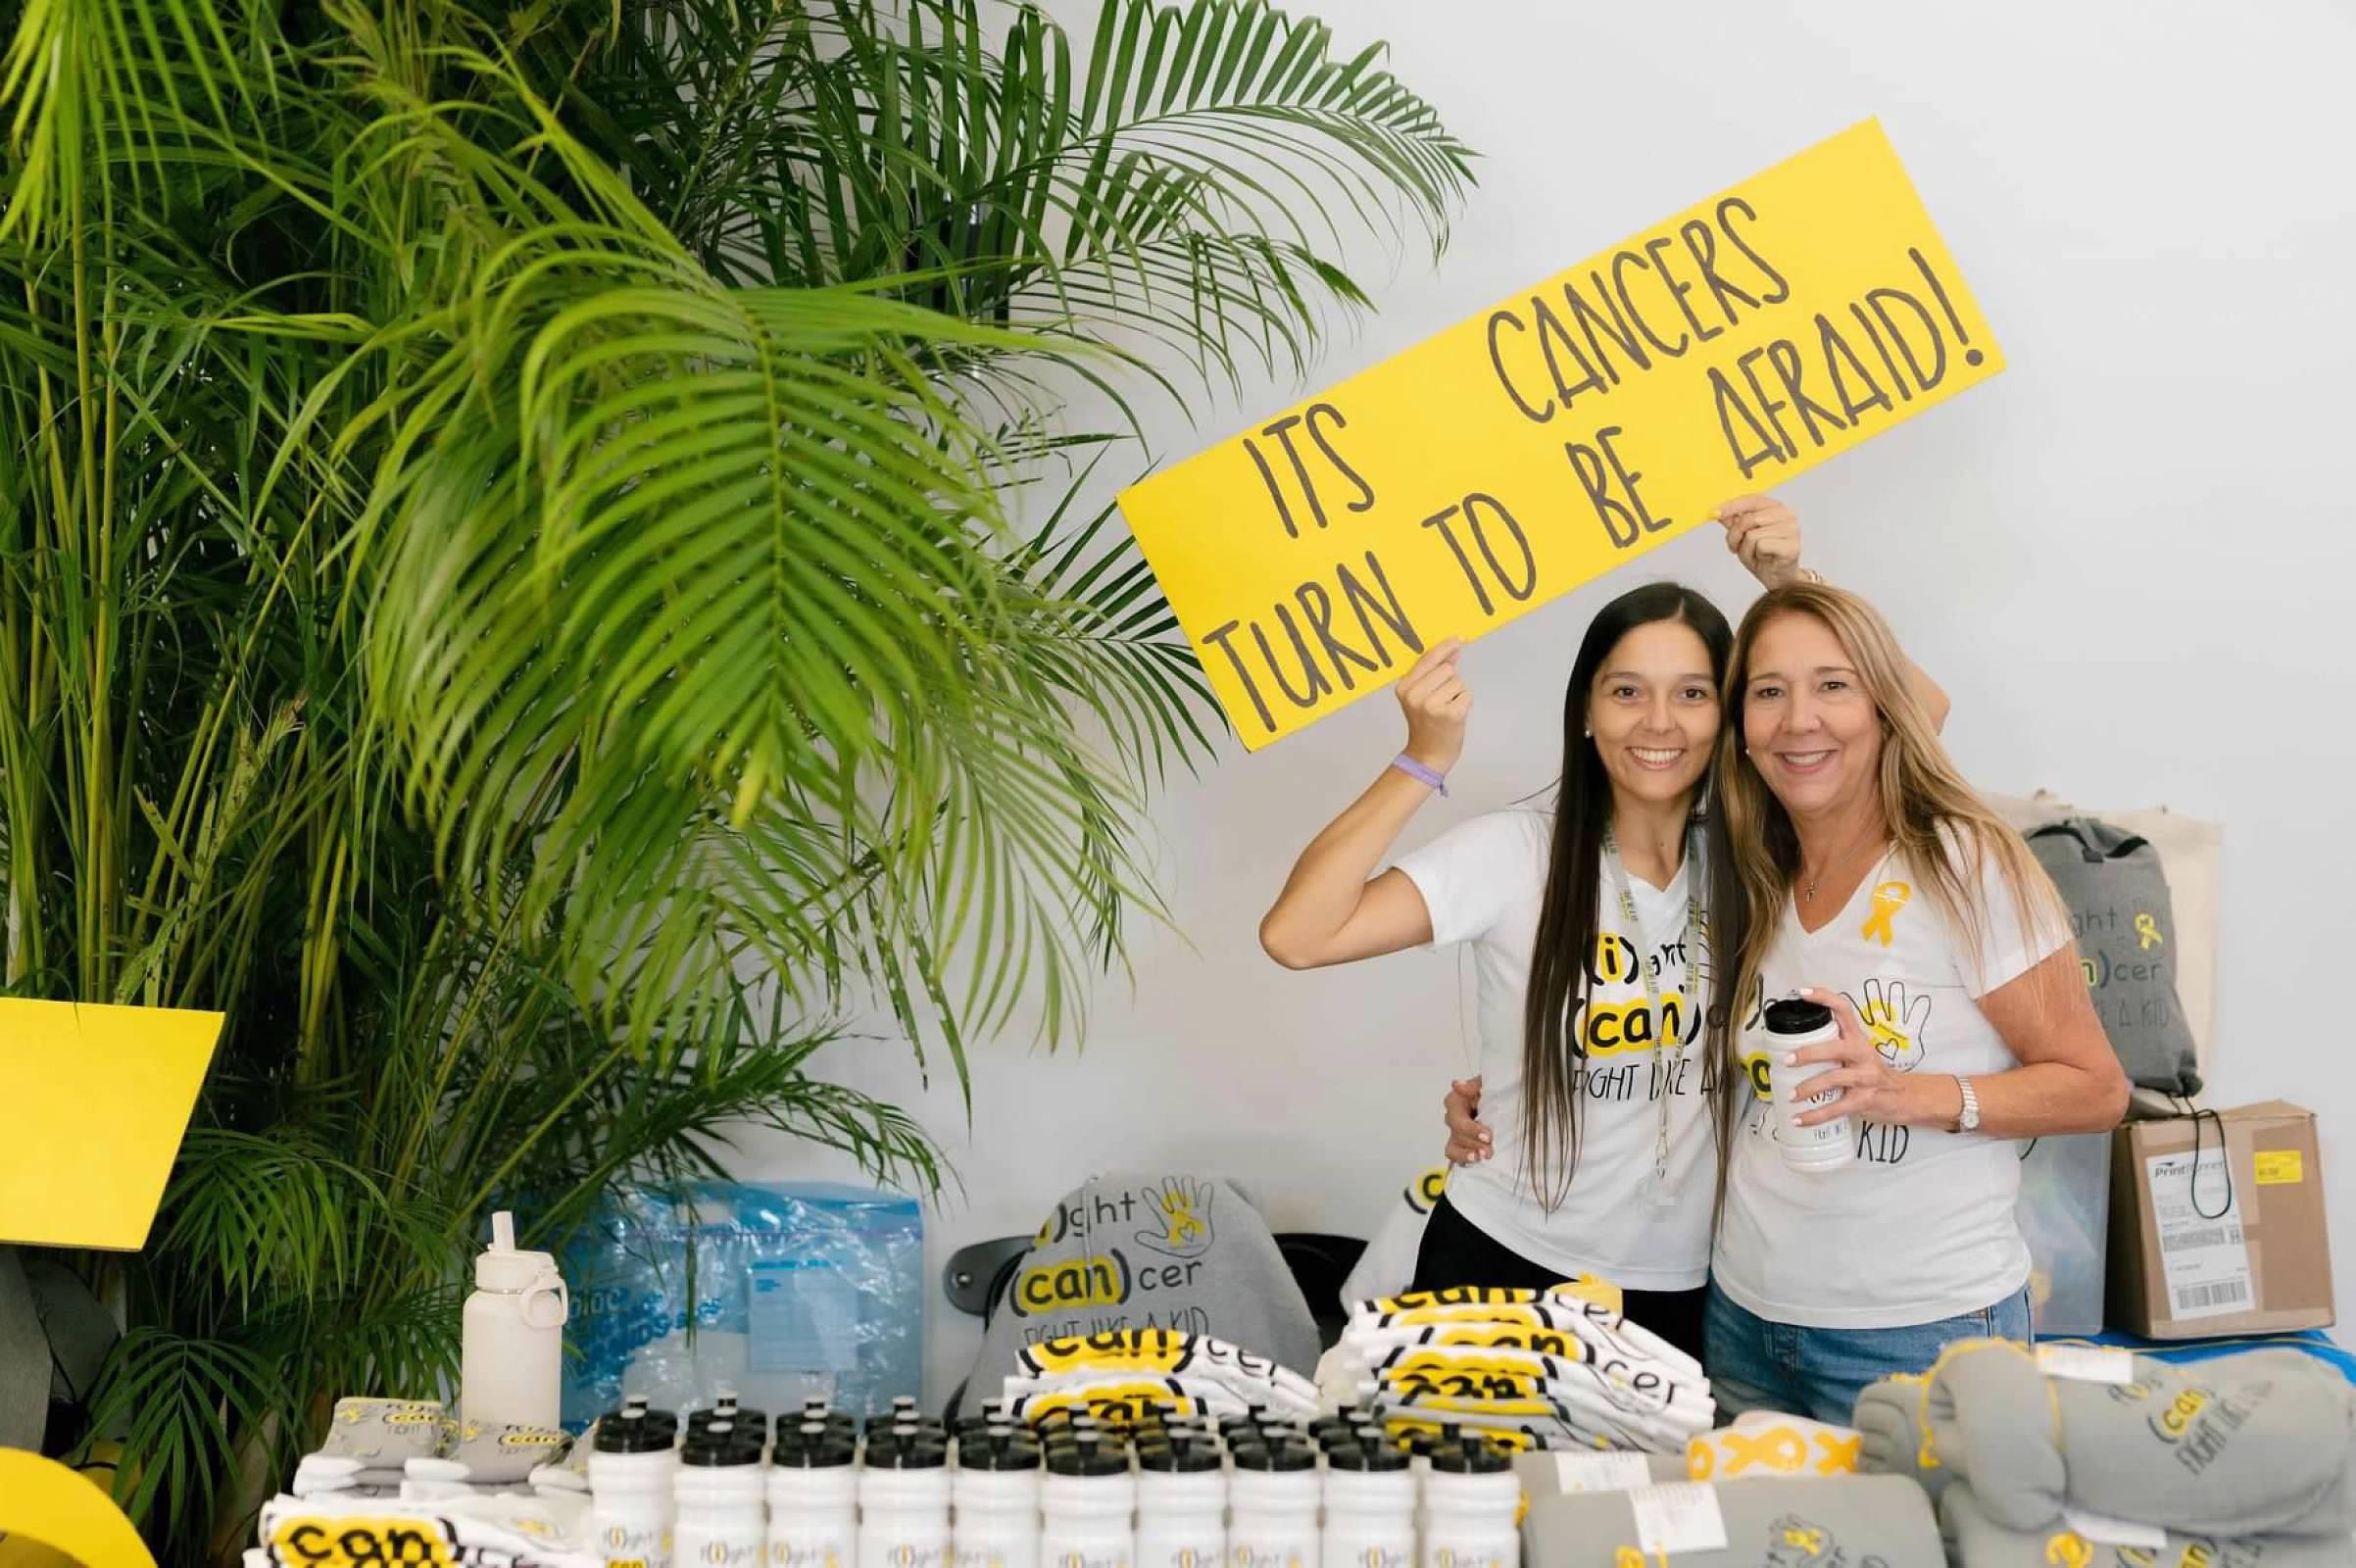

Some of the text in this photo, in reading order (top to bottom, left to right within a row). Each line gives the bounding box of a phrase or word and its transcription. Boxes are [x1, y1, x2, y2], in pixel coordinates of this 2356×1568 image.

[1245, 197, 1790, 539] ITS CANCERS
[1202, 247, 1984, 732] TURN TO BE AFRAID!
[1565, 984, 1702, 1059] (can)
[1857, 1120, 1910, 1164] KID
